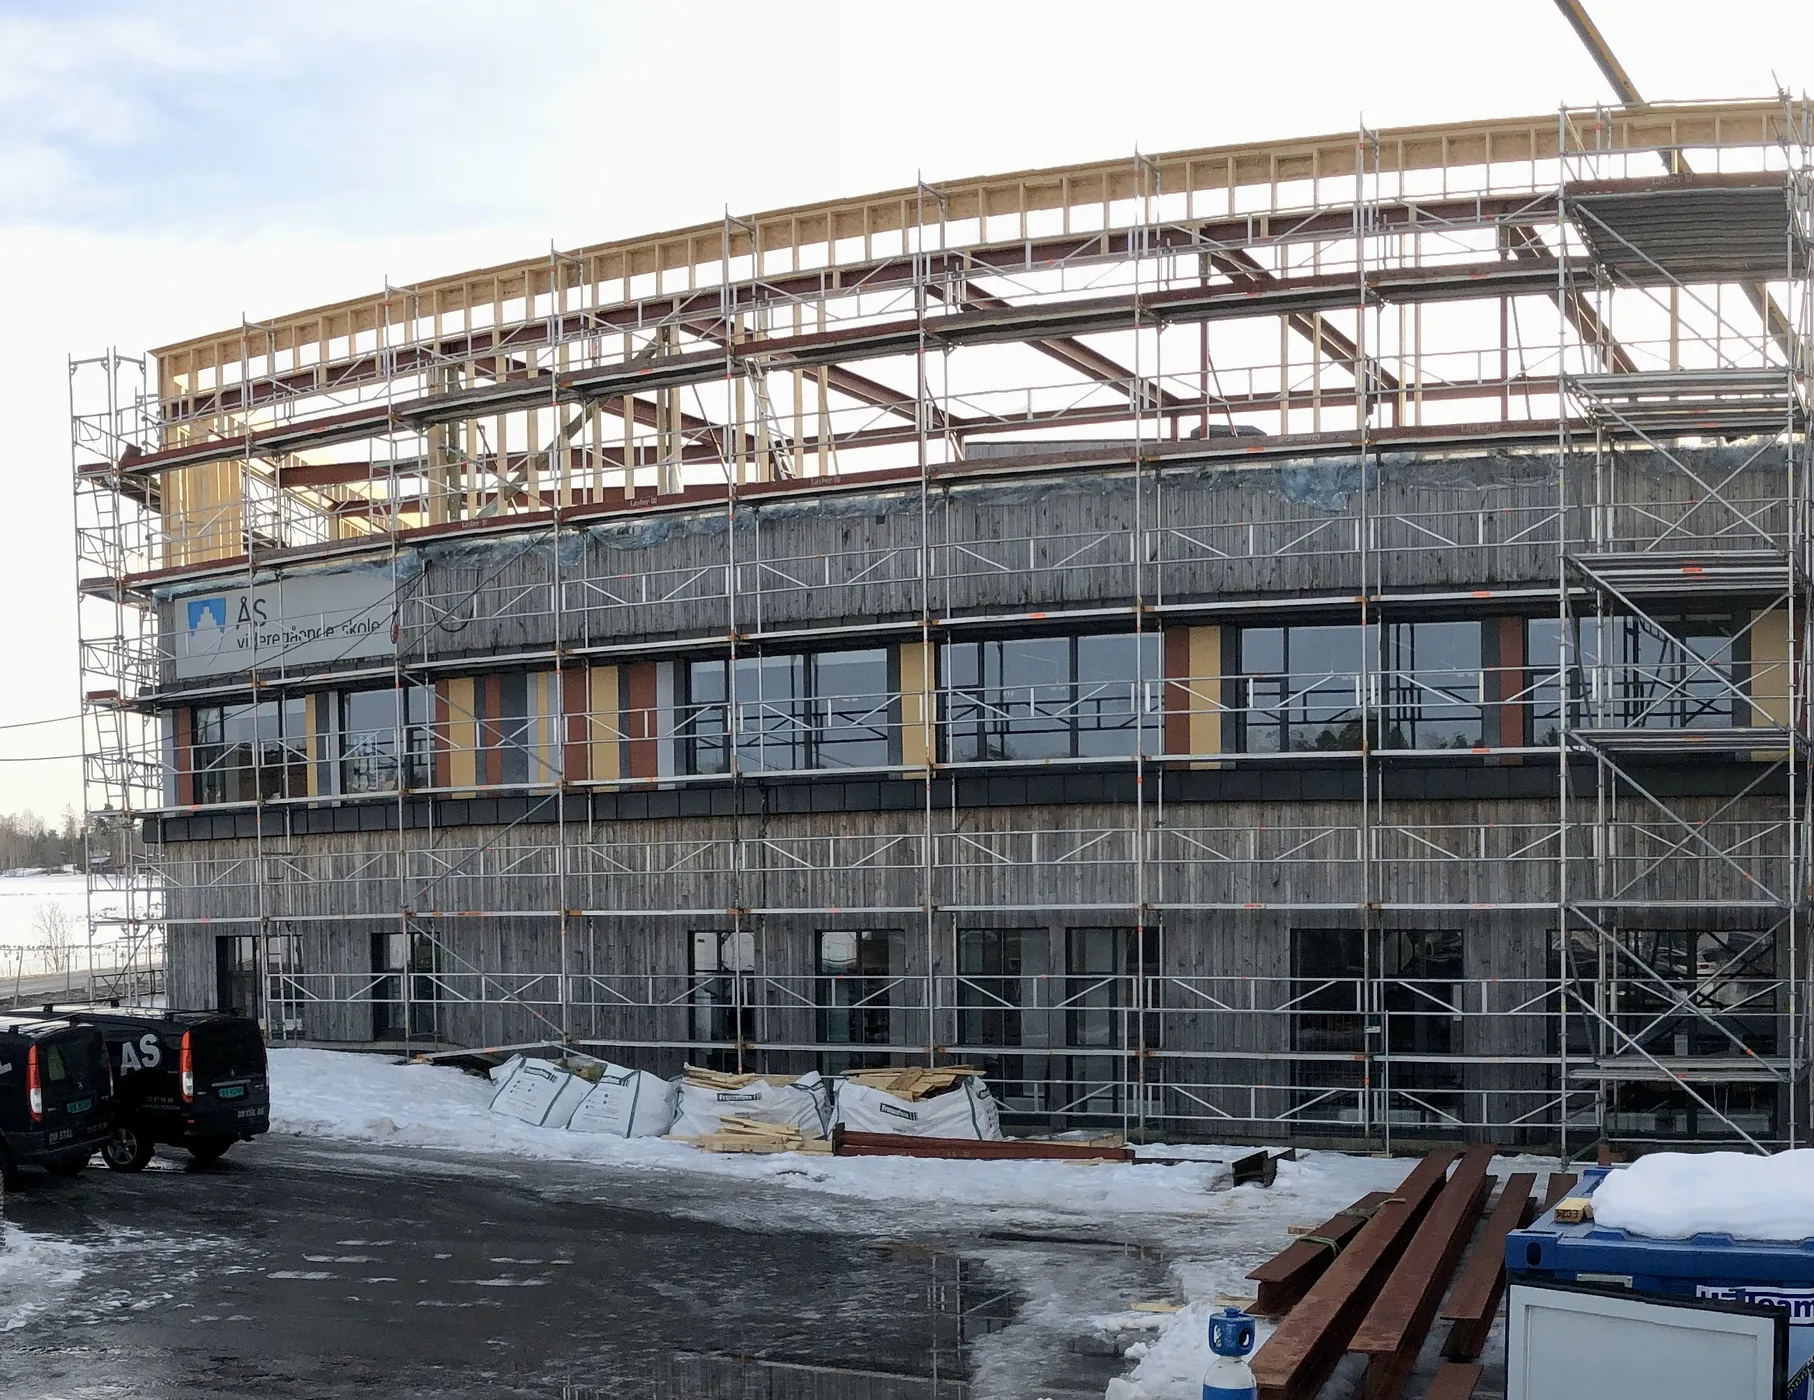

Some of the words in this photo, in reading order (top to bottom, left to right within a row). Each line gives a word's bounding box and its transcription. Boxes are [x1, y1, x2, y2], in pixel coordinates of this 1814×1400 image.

[236, 596, 267, 630] ÅS
[342, 617, 380, 635] skole
[120, 1033, 162, 1077] AS
